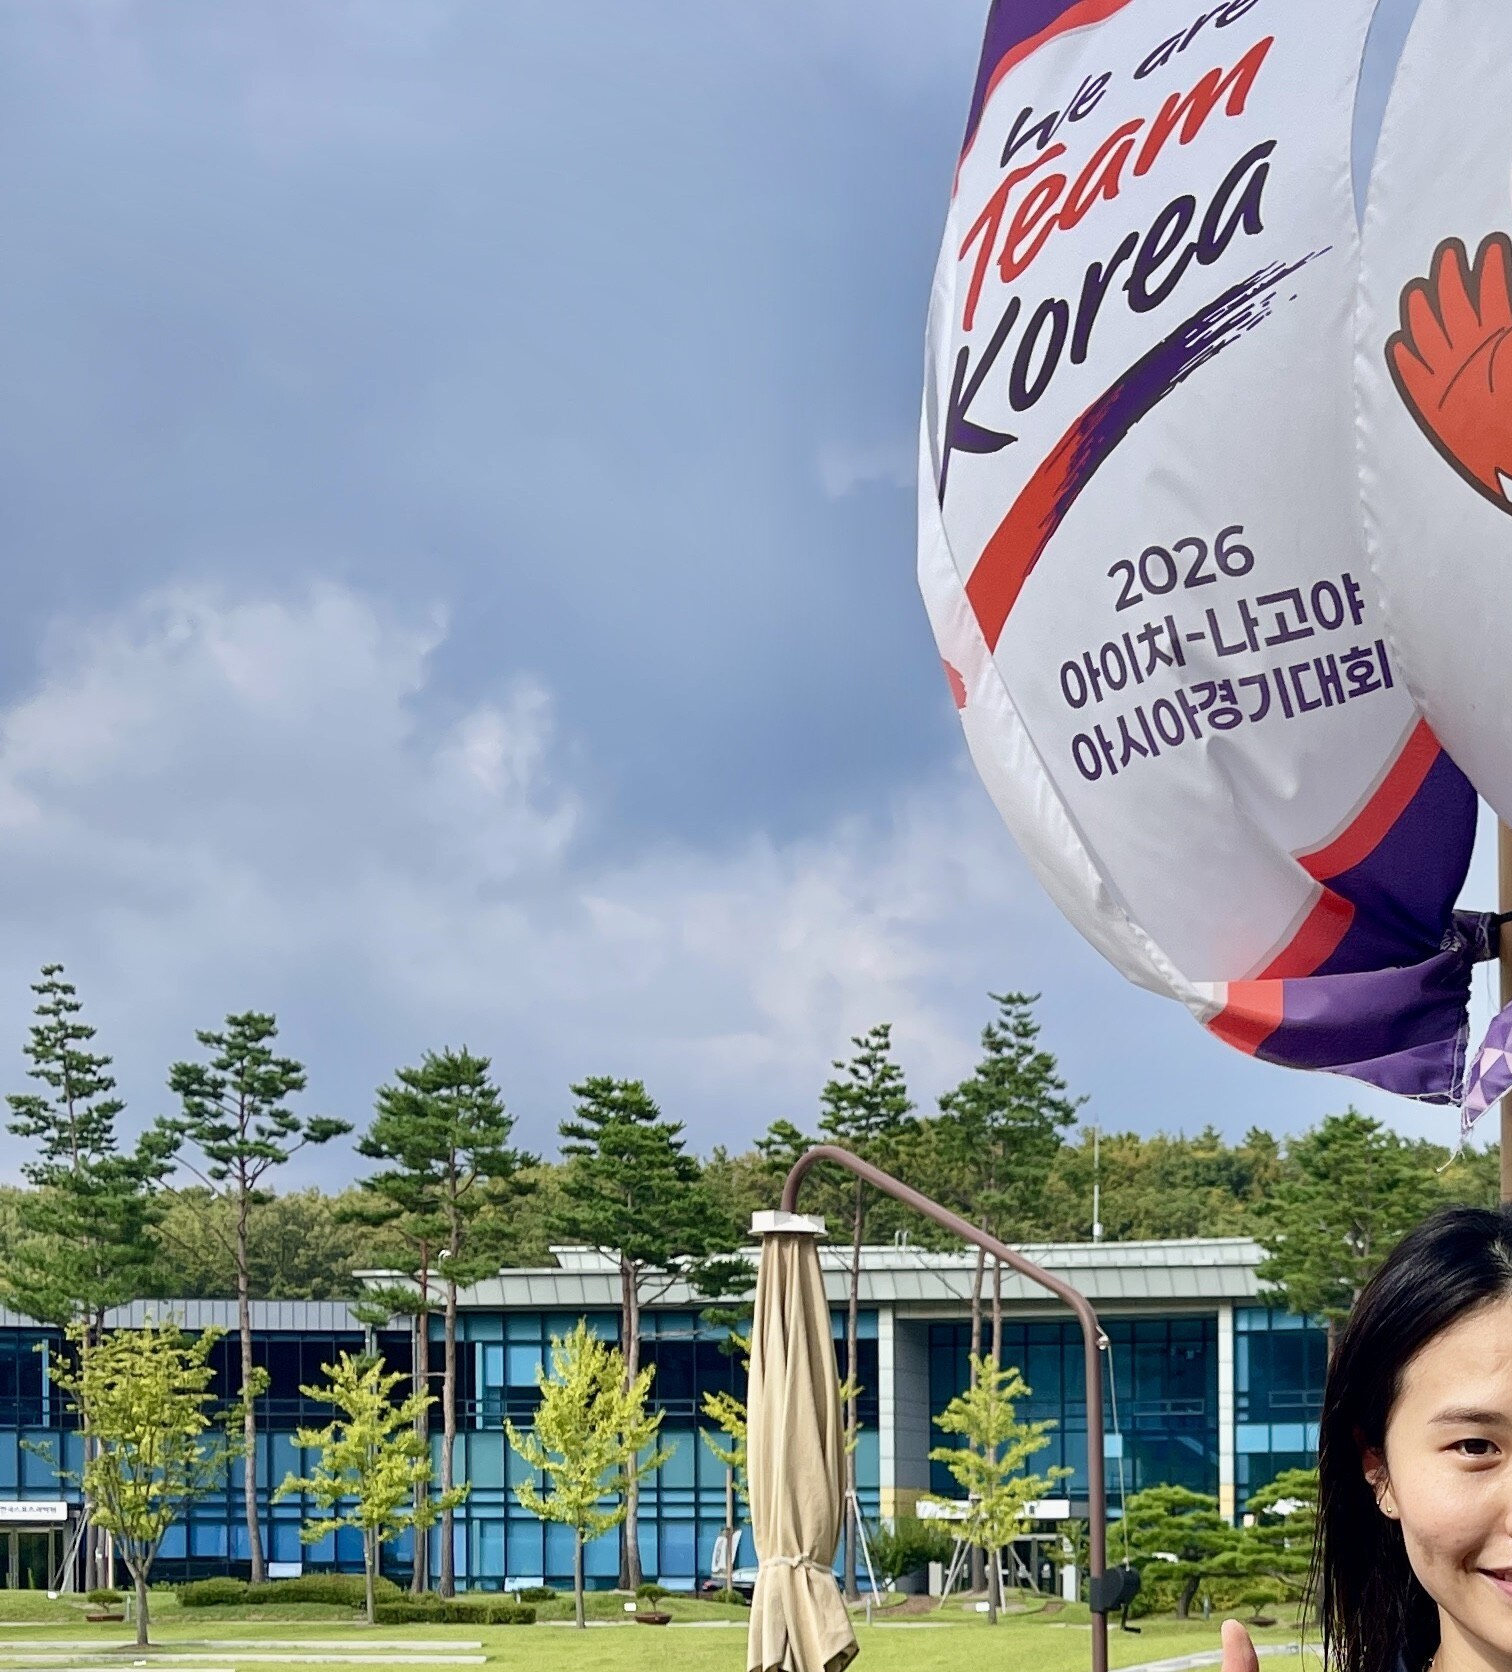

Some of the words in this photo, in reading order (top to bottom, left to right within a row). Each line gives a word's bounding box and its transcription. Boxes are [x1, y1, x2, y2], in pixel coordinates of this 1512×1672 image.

[1000, 71, 1112, 168] We
[1133, 0, 1259, 80] are
[958, 35, 1275, 332] Team
[937, 139, 1278, 514] Korea
[1060, 572, 1366, 710] 아이치-나고야
[1106, 524, 1255, 612] 2026
[1071, 638, 1395, 782] 아시아경기대회
